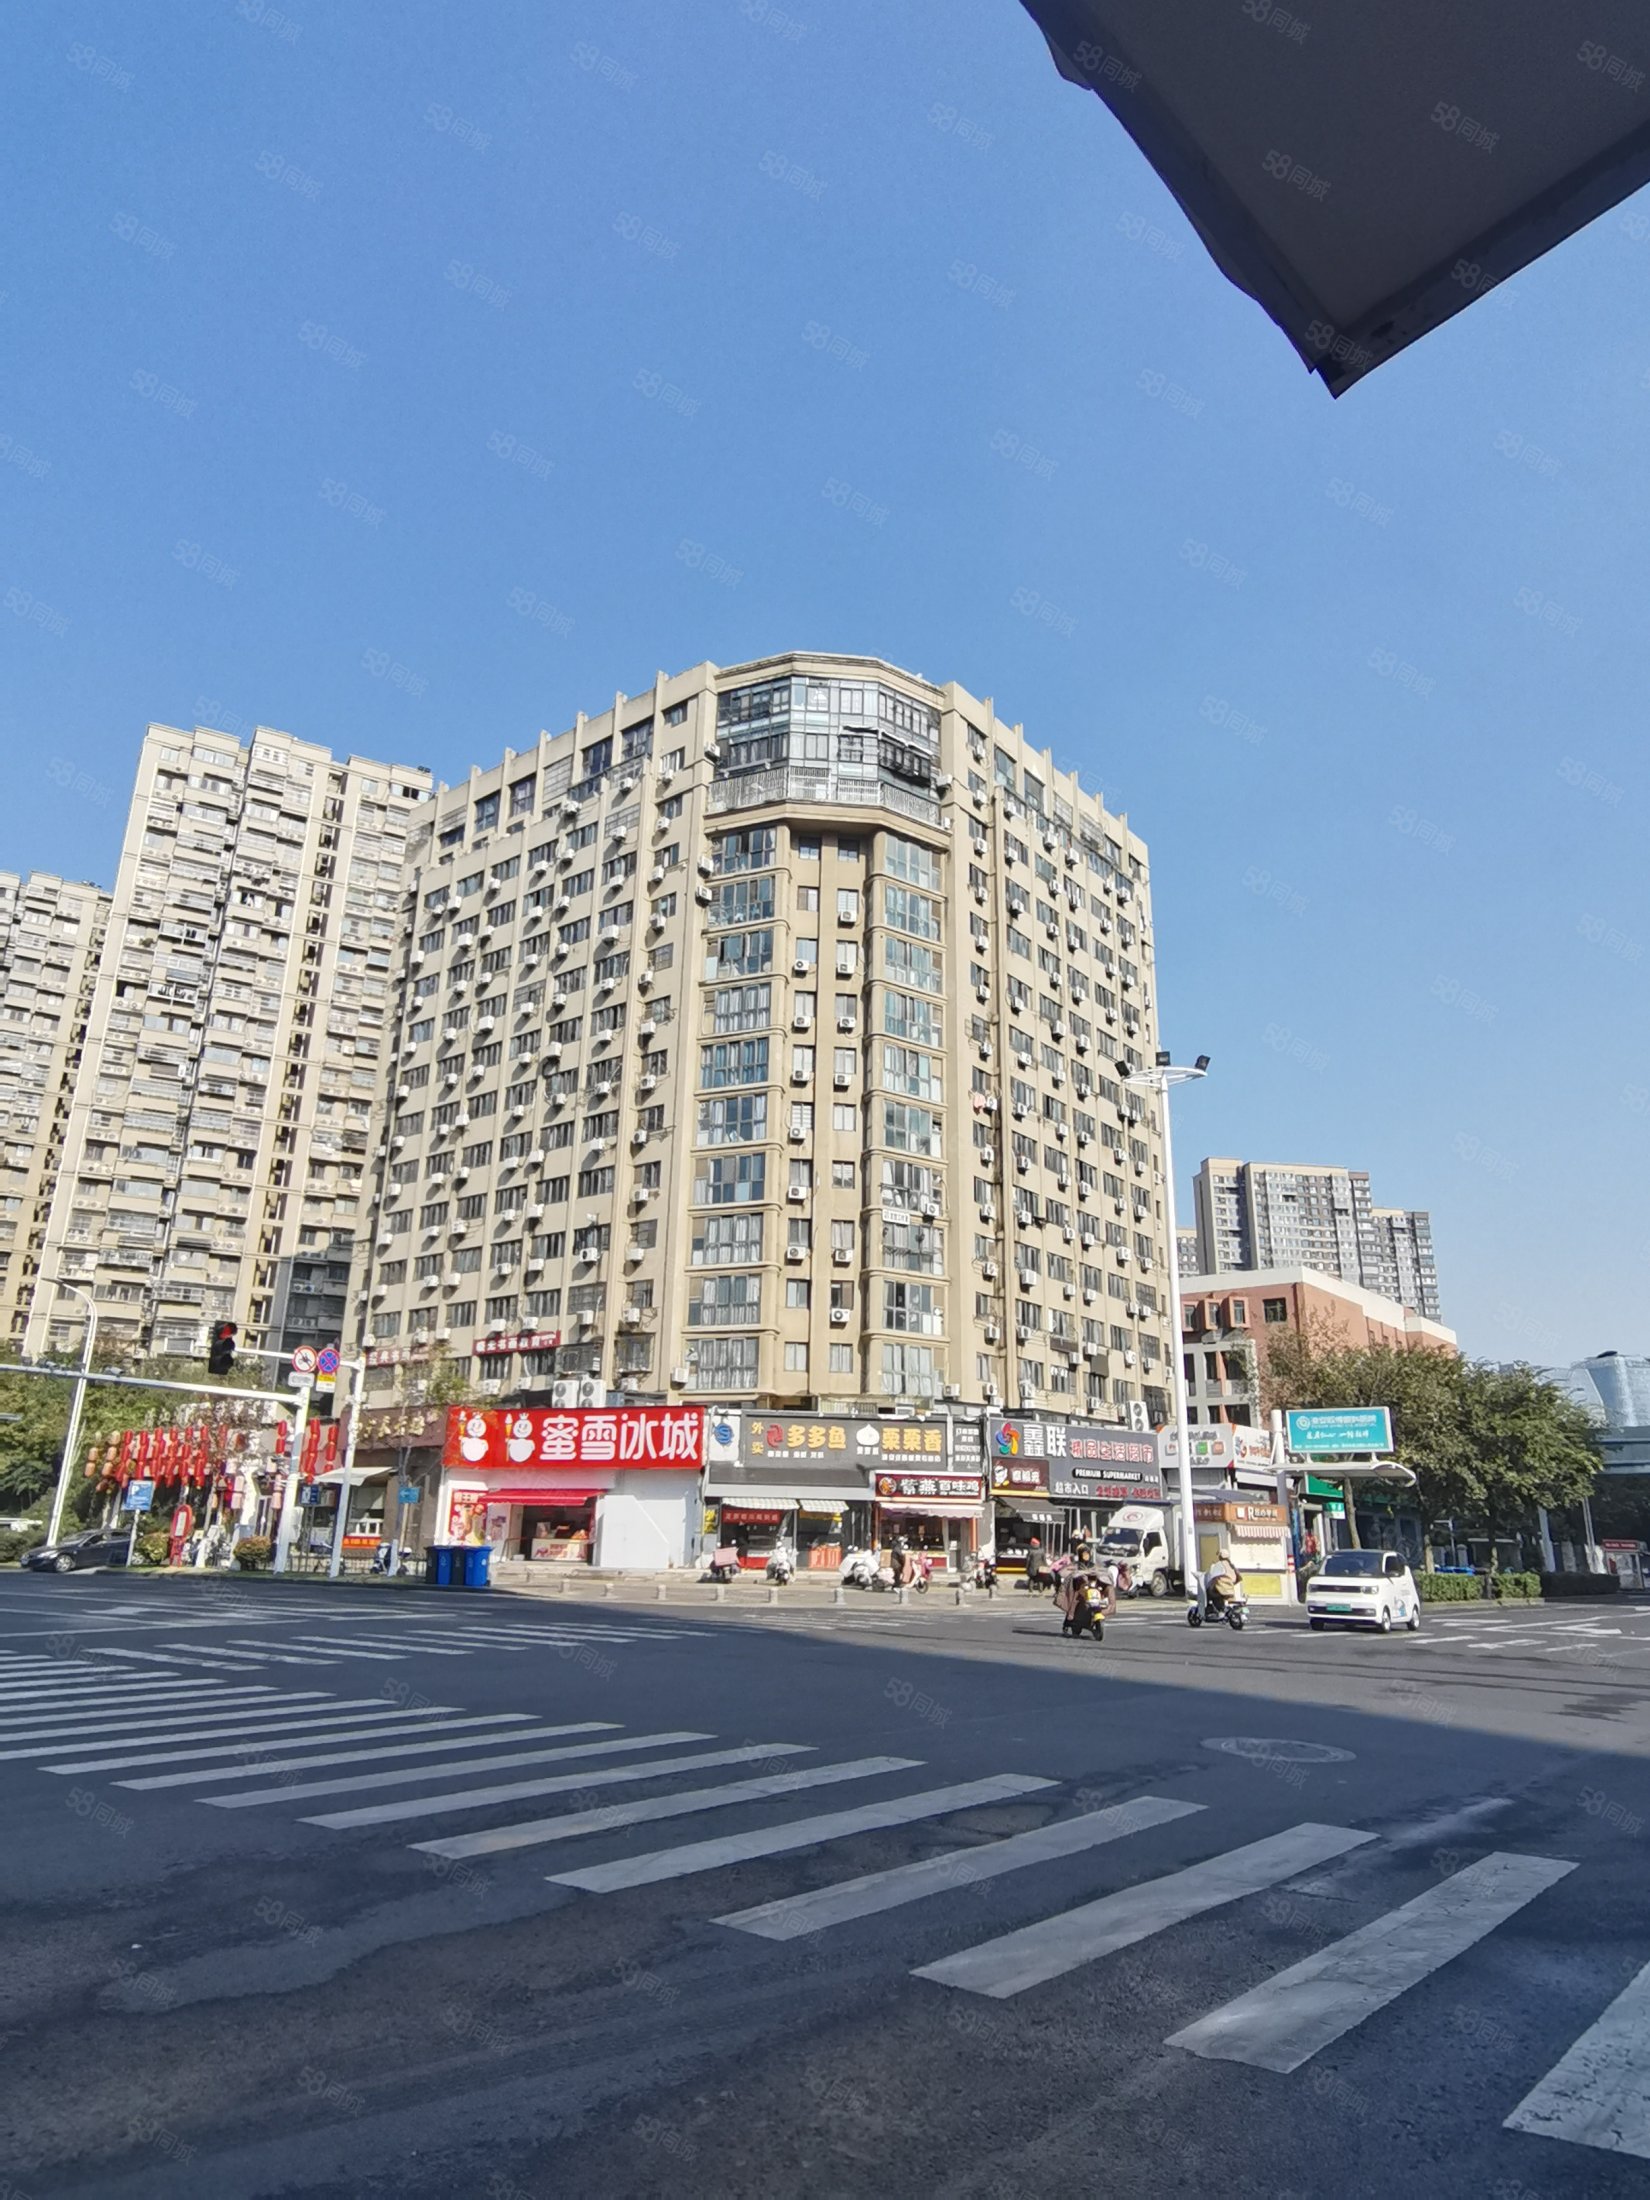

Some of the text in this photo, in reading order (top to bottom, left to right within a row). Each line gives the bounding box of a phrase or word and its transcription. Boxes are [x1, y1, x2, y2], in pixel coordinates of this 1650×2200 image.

[540, 1412, 698, 1461] 蜜雪冰城
[786, 1424, 847, 1450] 多多鱼
[1023, 1424, 1154, 1464] 鑫联 精品生活超市
[1075, 1468, 1102, 1478] PREMIUM
[1102, 1469, 1141, 1481] SUPERMARKET
[1054, 1481, 1090, 1496] 超市入口
